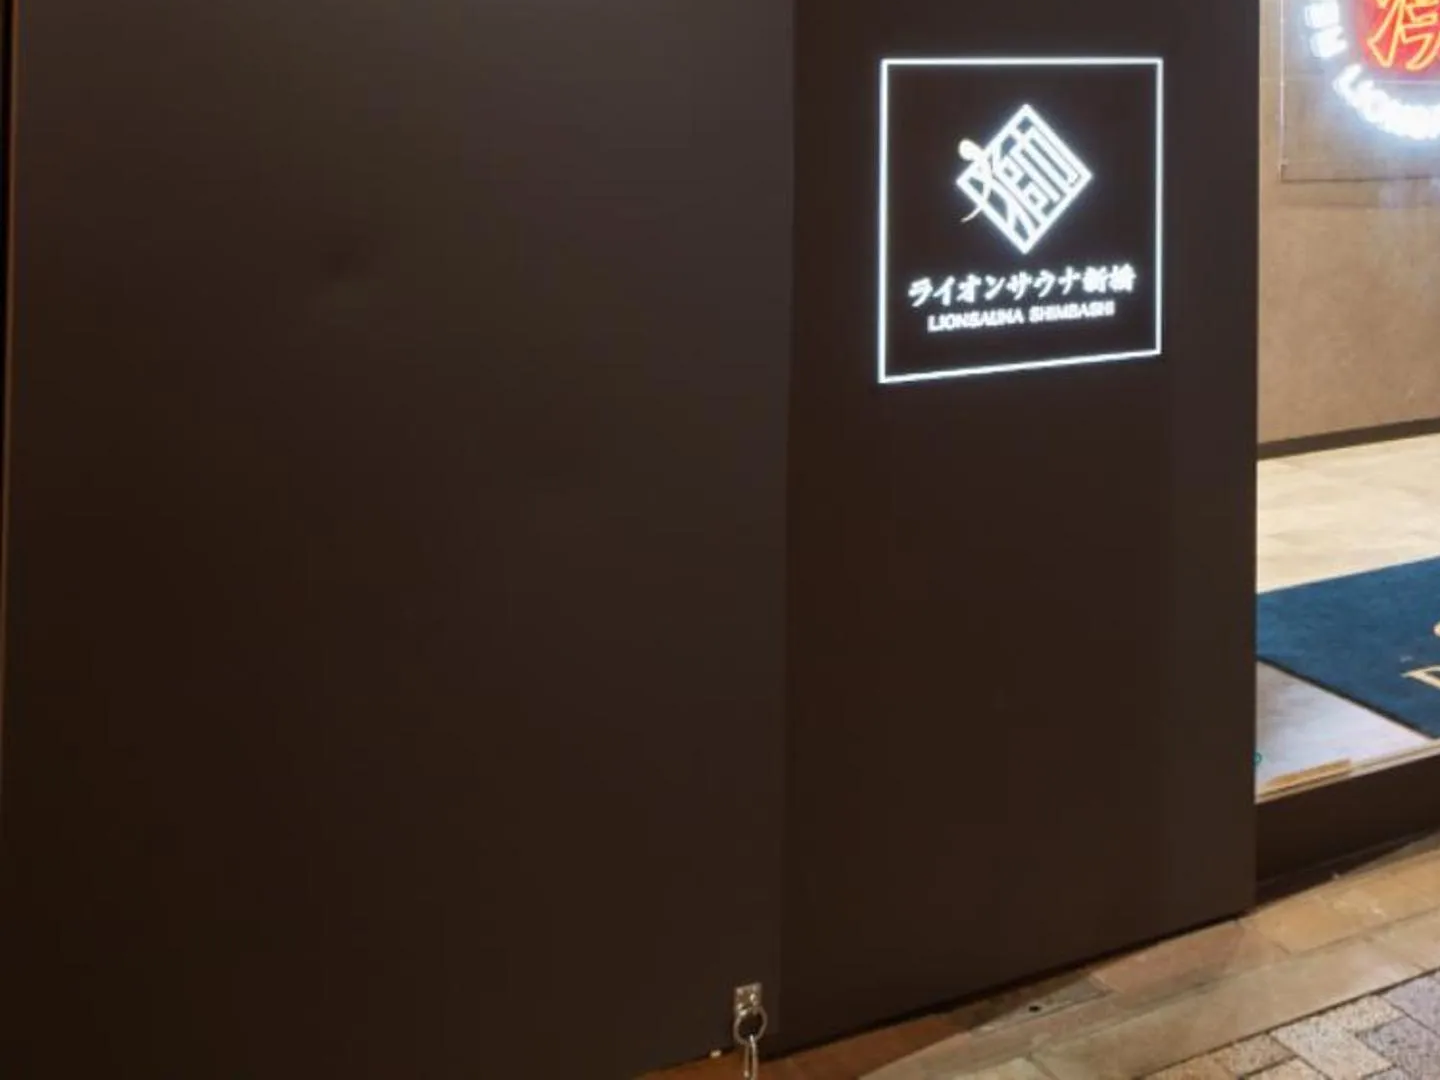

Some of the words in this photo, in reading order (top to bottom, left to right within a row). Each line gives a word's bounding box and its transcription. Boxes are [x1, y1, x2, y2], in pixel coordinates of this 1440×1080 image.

[908, 263, 1137, 308] ライオンサウナ新橋
[1028, 301, 1116, 322] SHIMBASHI
